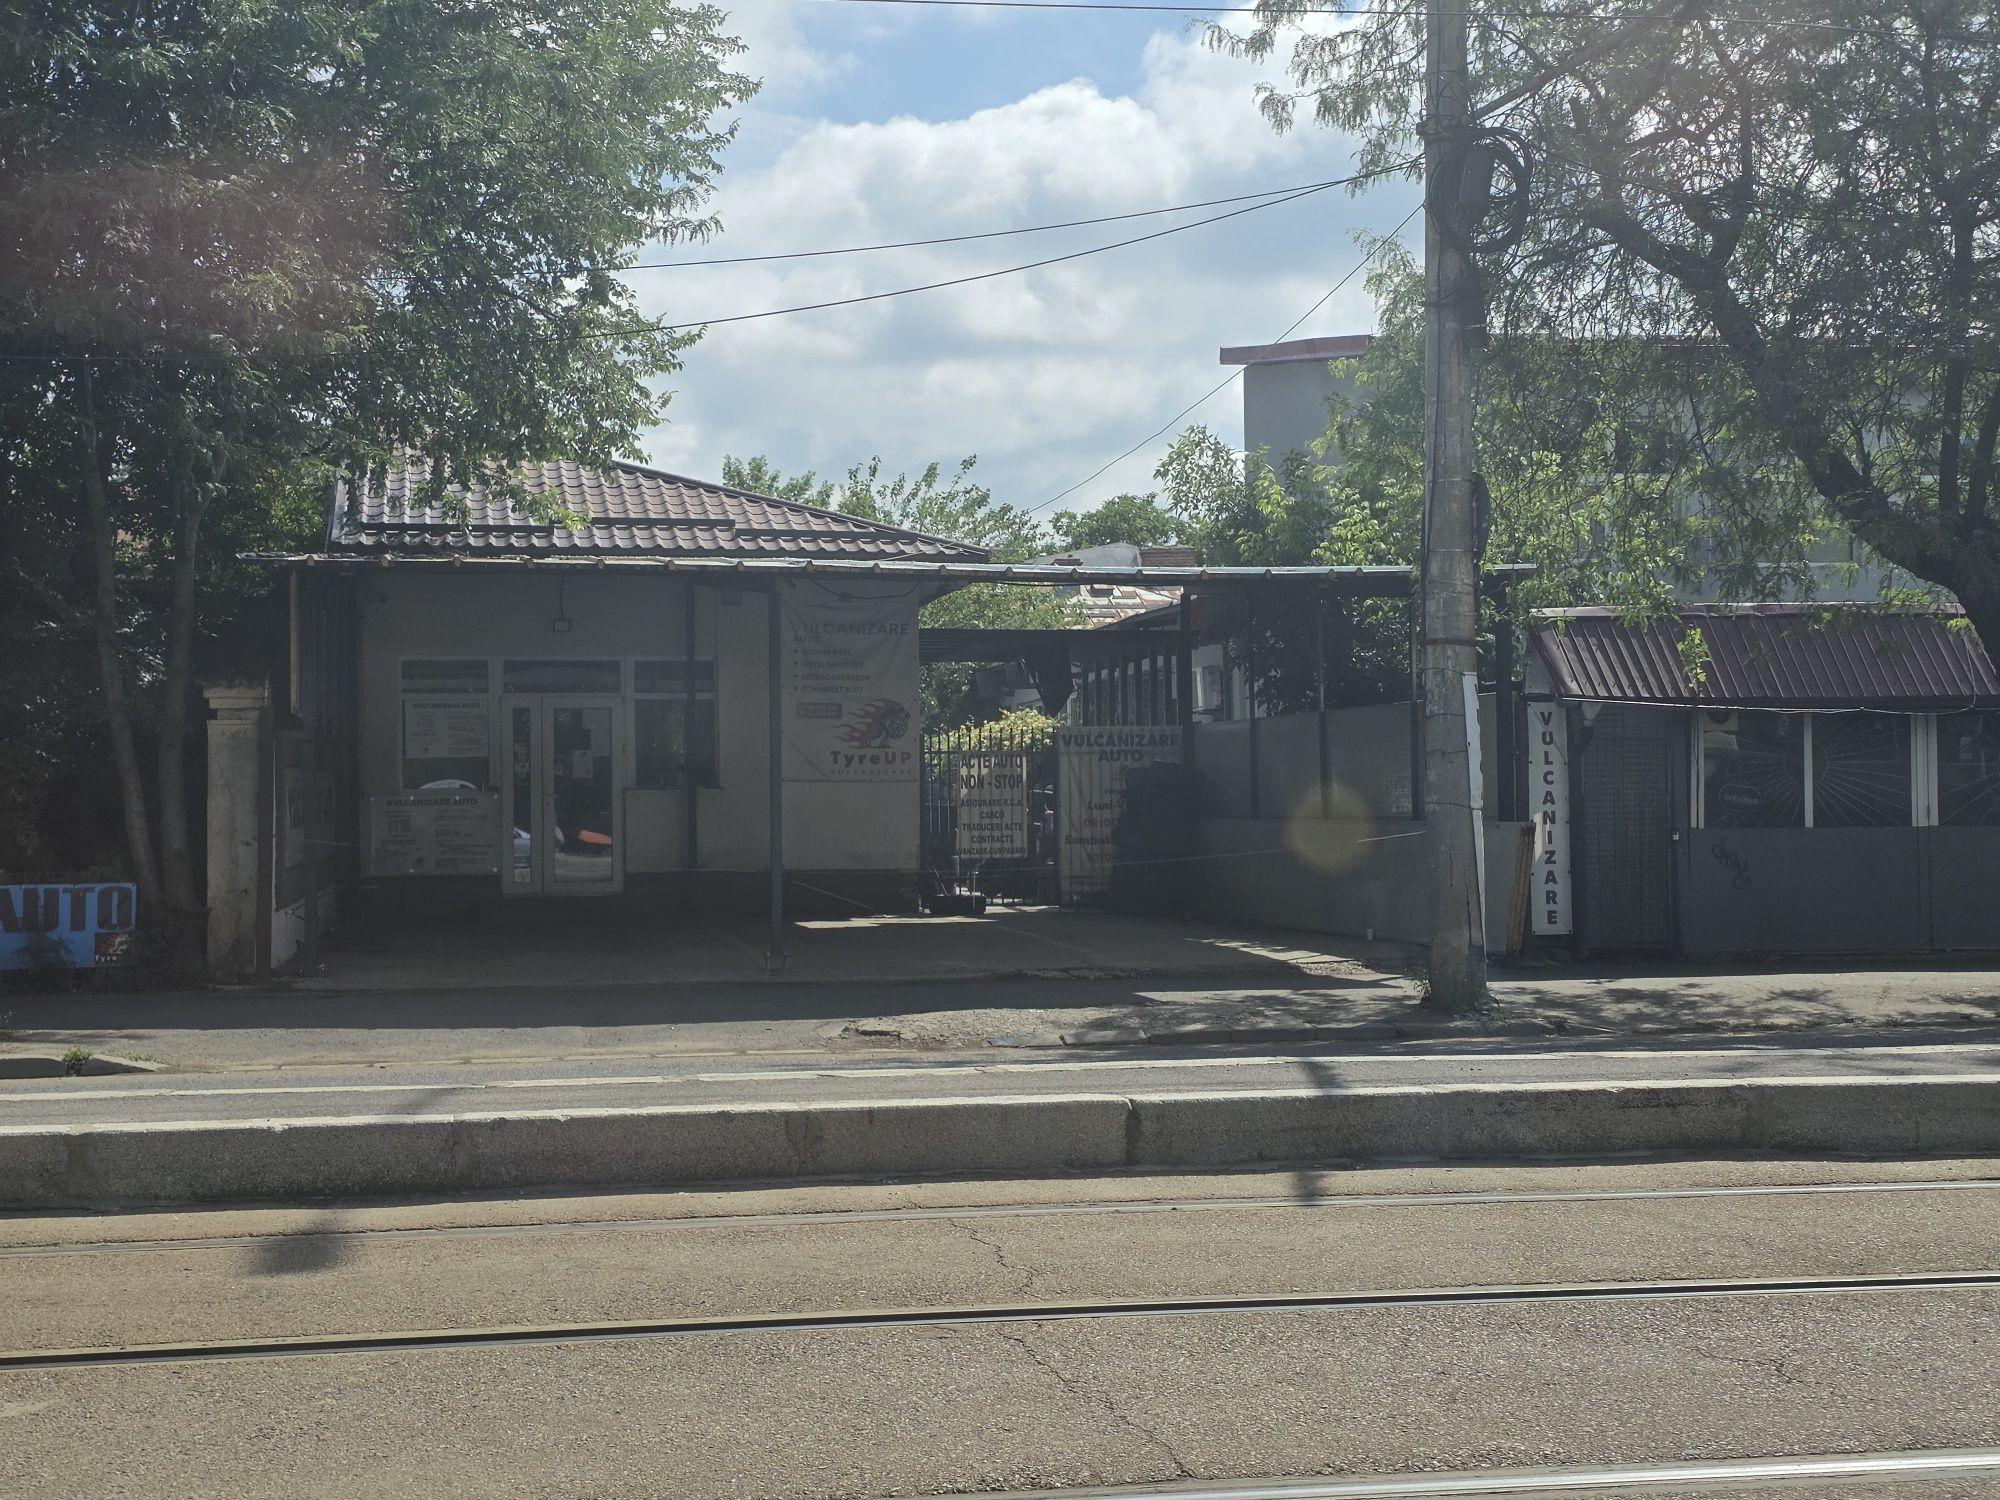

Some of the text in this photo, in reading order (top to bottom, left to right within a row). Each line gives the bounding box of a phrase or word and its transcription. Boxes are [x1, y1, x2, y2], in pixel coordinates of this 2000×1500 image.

[791, 621, 909, 635] VULCANIZARE
[1061, 734, 1179, 748] VULCANIZARE
[830, 751, 912, 768] TyreUP
[961, 753, 1023, 769] ACTE AUTO
[1098, 749, 1144, 762] AUTO
[961, 774, 985, 790] NON
[994, 774, 1023, 790] STOP
[1539, 711, 1558, 925] VULCANIZARE
